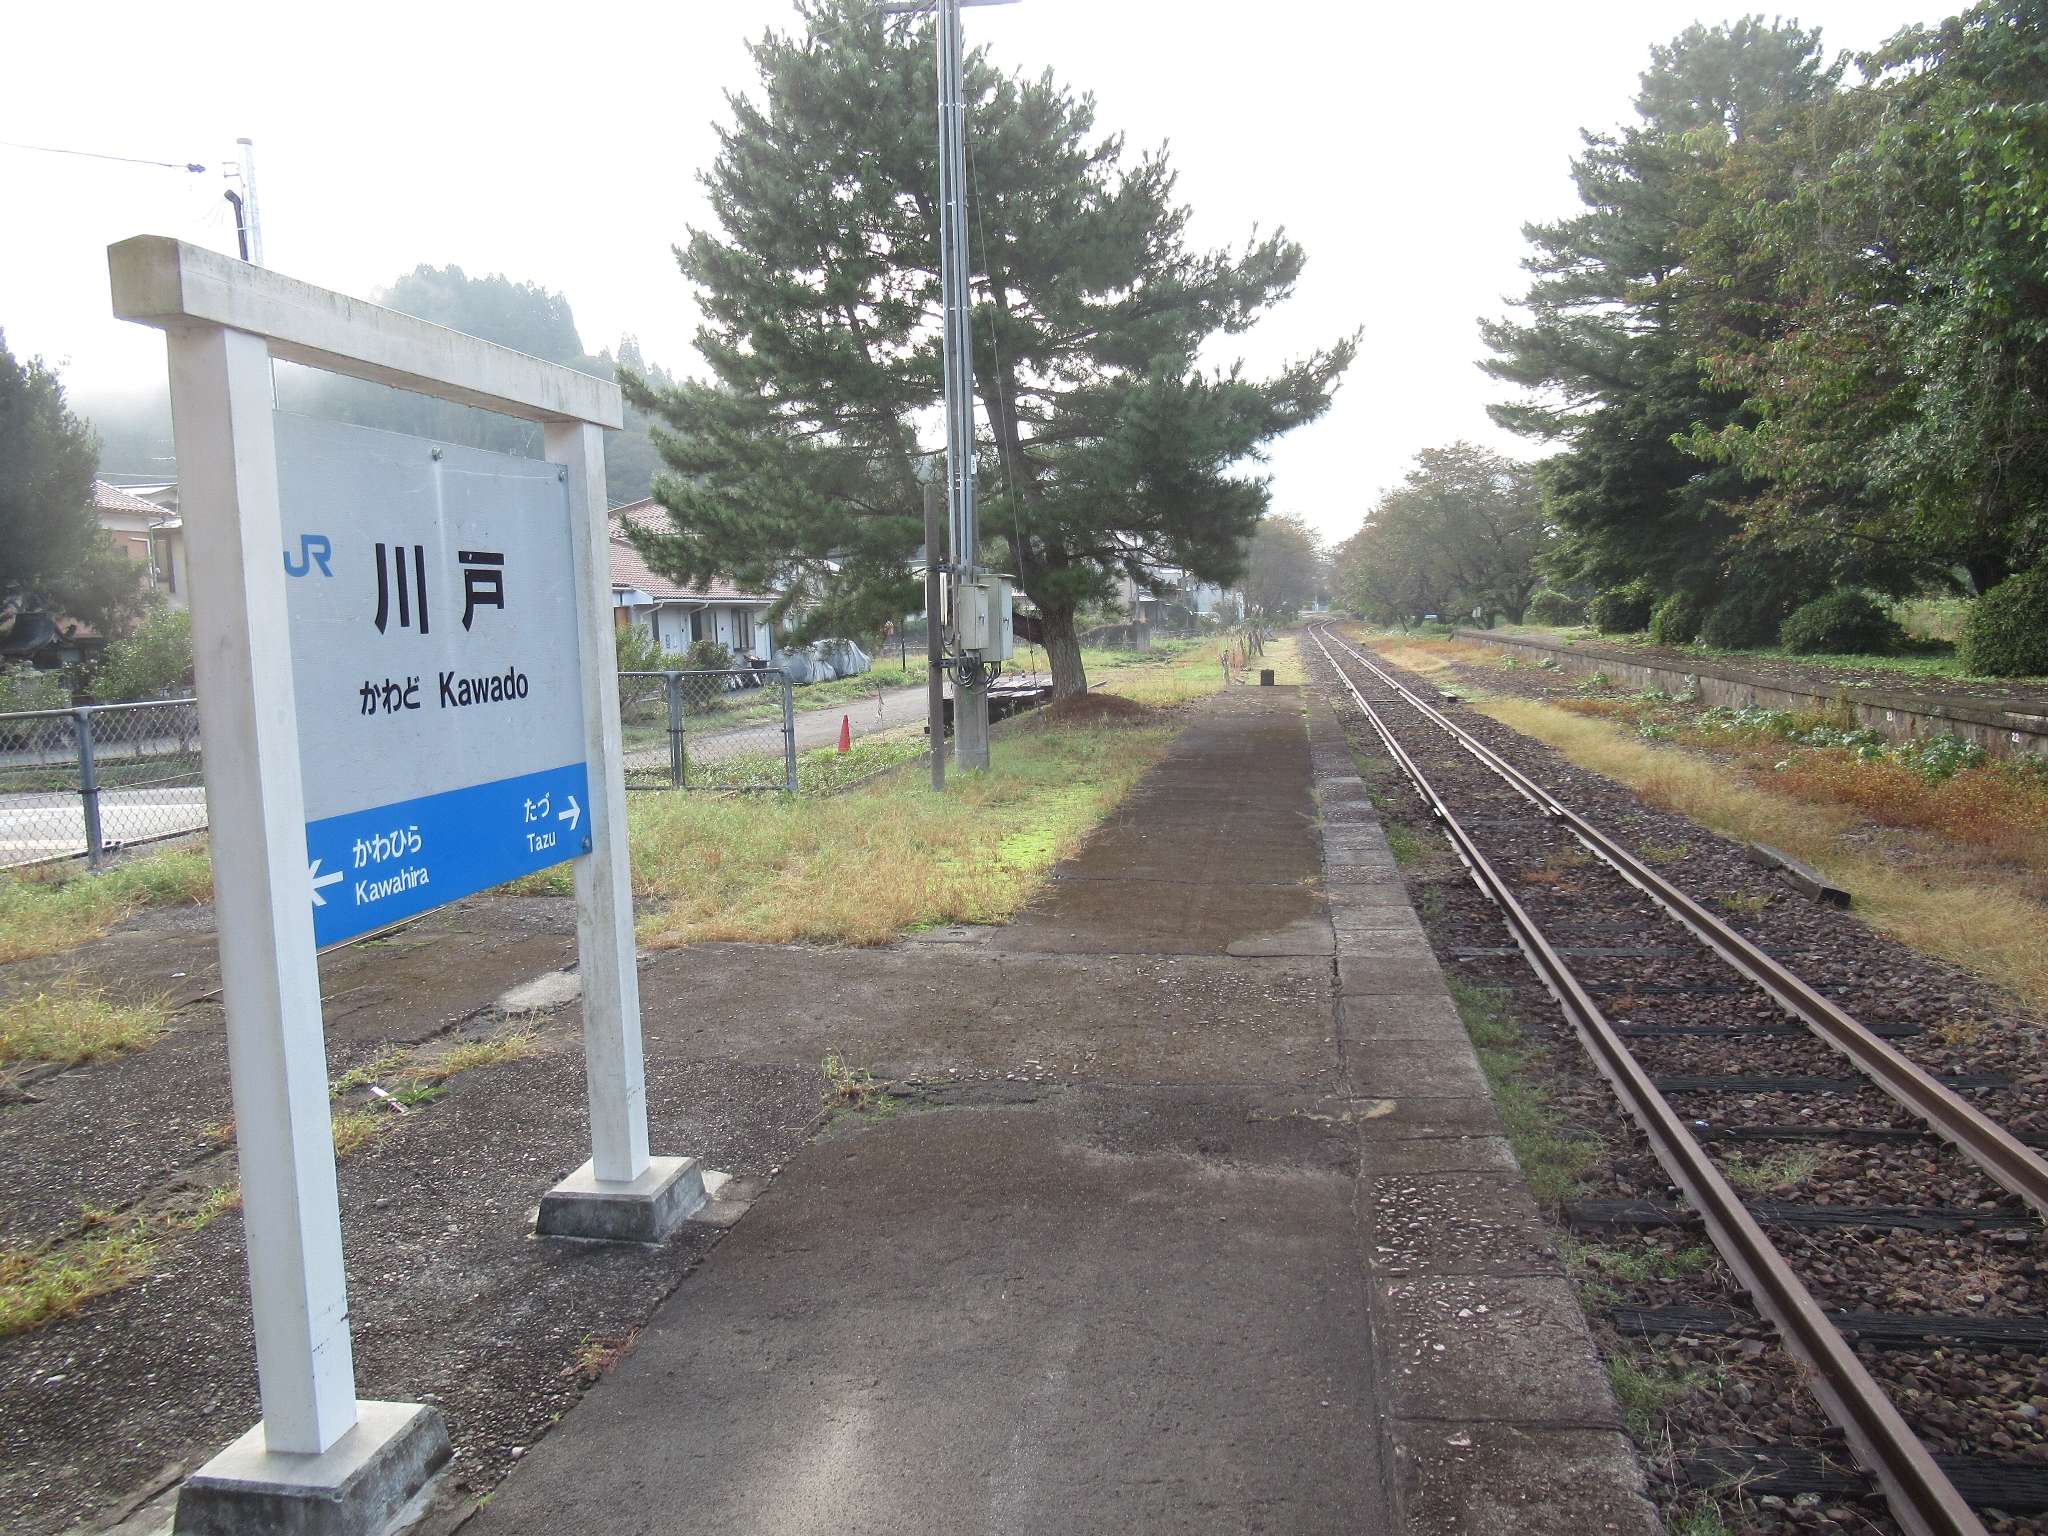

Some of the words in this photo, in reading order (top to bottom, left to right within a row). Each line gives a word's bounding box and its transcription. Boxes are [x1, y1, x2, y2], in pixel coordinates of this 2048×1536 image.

[283, 534, 334, 578] JR
[374, 543, 505, 635] 川戸
[359, 676, 421, 716] かわど
[439, 666, 529, 709] Kawado
[523, 791, 551, 823] たづ
[352, 824, 422, 869] かわひら
[526, 831, 557, 854] Tazu
[355, 865, 430, 905] Kawahira
